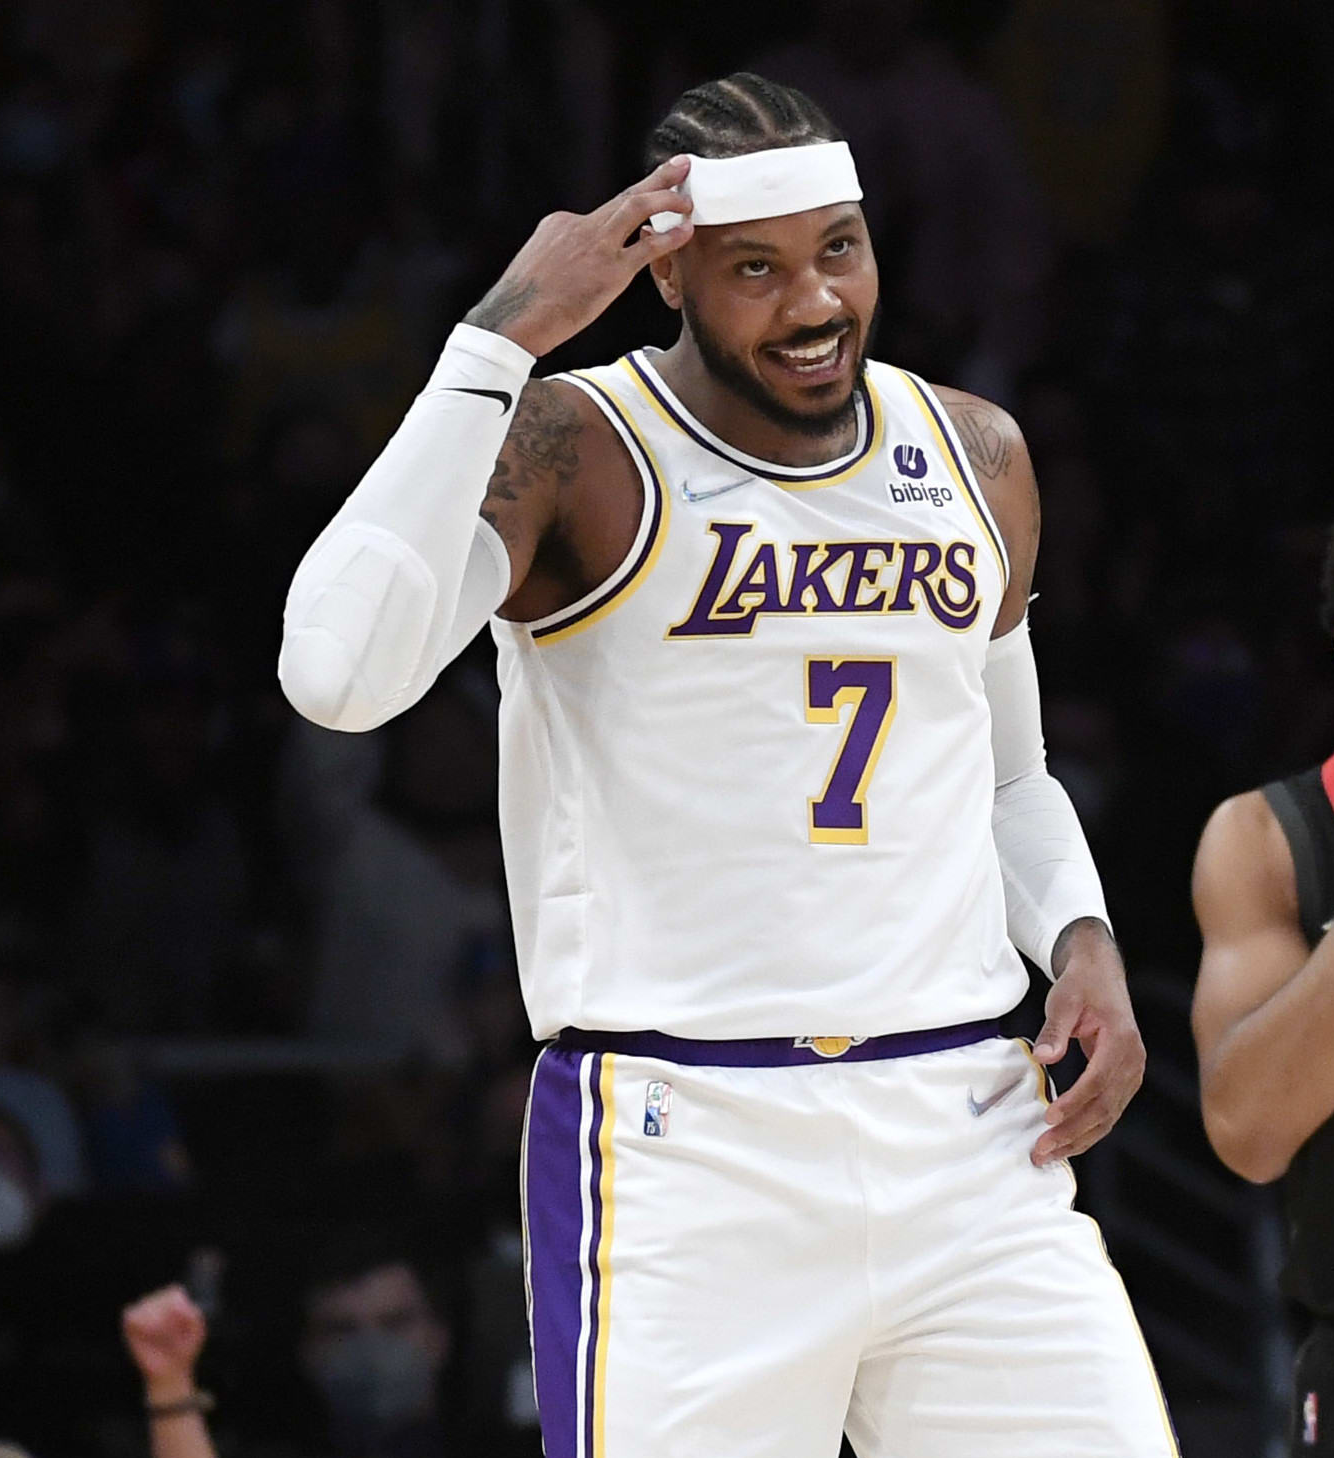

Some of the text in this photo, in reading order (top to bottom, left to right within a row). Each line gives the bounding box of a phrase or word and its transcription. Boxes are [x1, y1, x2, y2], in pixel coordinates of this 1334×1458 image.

[889, 482, 953, 507] bibigo
[663, 518, 982, 640] LAKERS
[804, 655, 898, 845] 7
